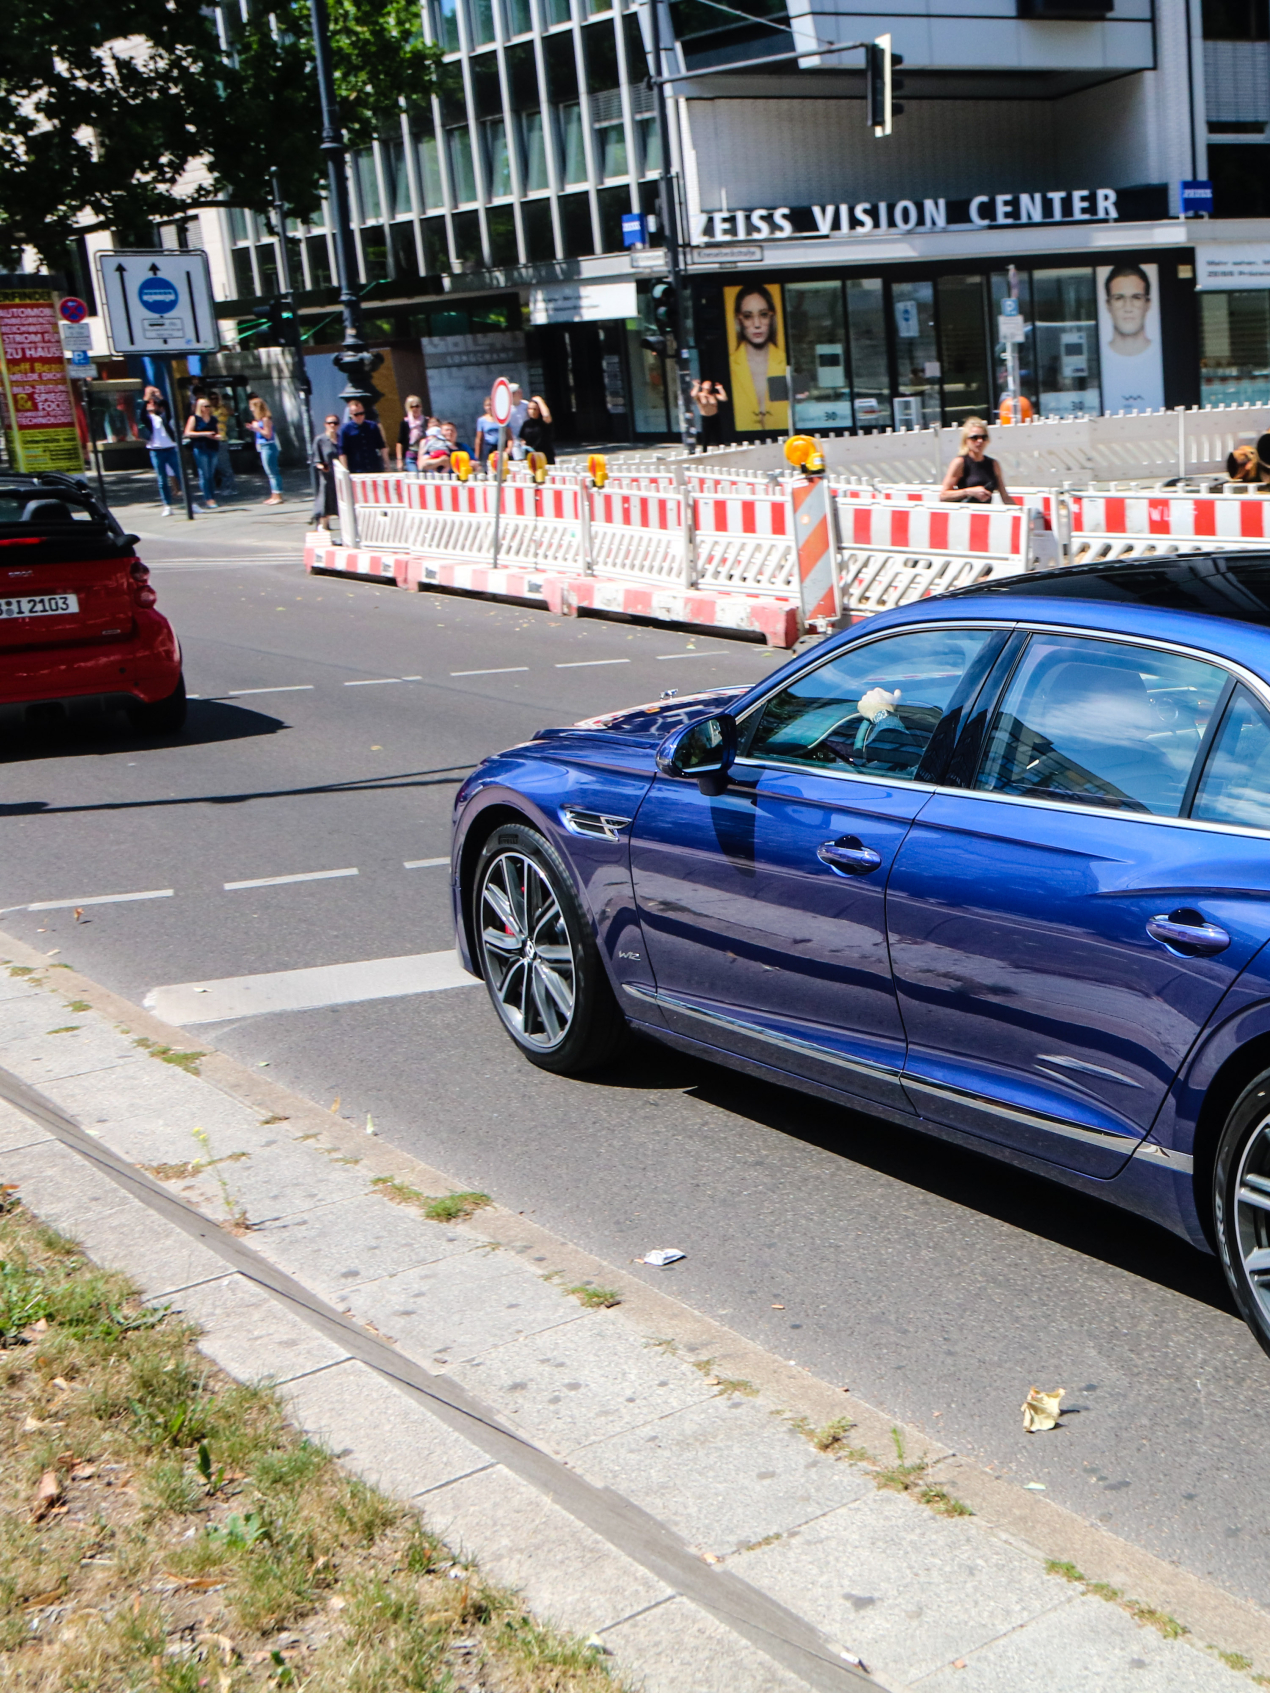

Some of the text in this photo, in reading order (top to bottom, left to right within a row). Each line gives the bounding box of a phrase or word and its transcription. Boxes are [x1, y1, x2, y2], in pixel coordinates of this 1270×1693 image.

[691, 187, 1119, 243] ZEISS VISION CENTER
[27, 596, 70, 614] 2103
